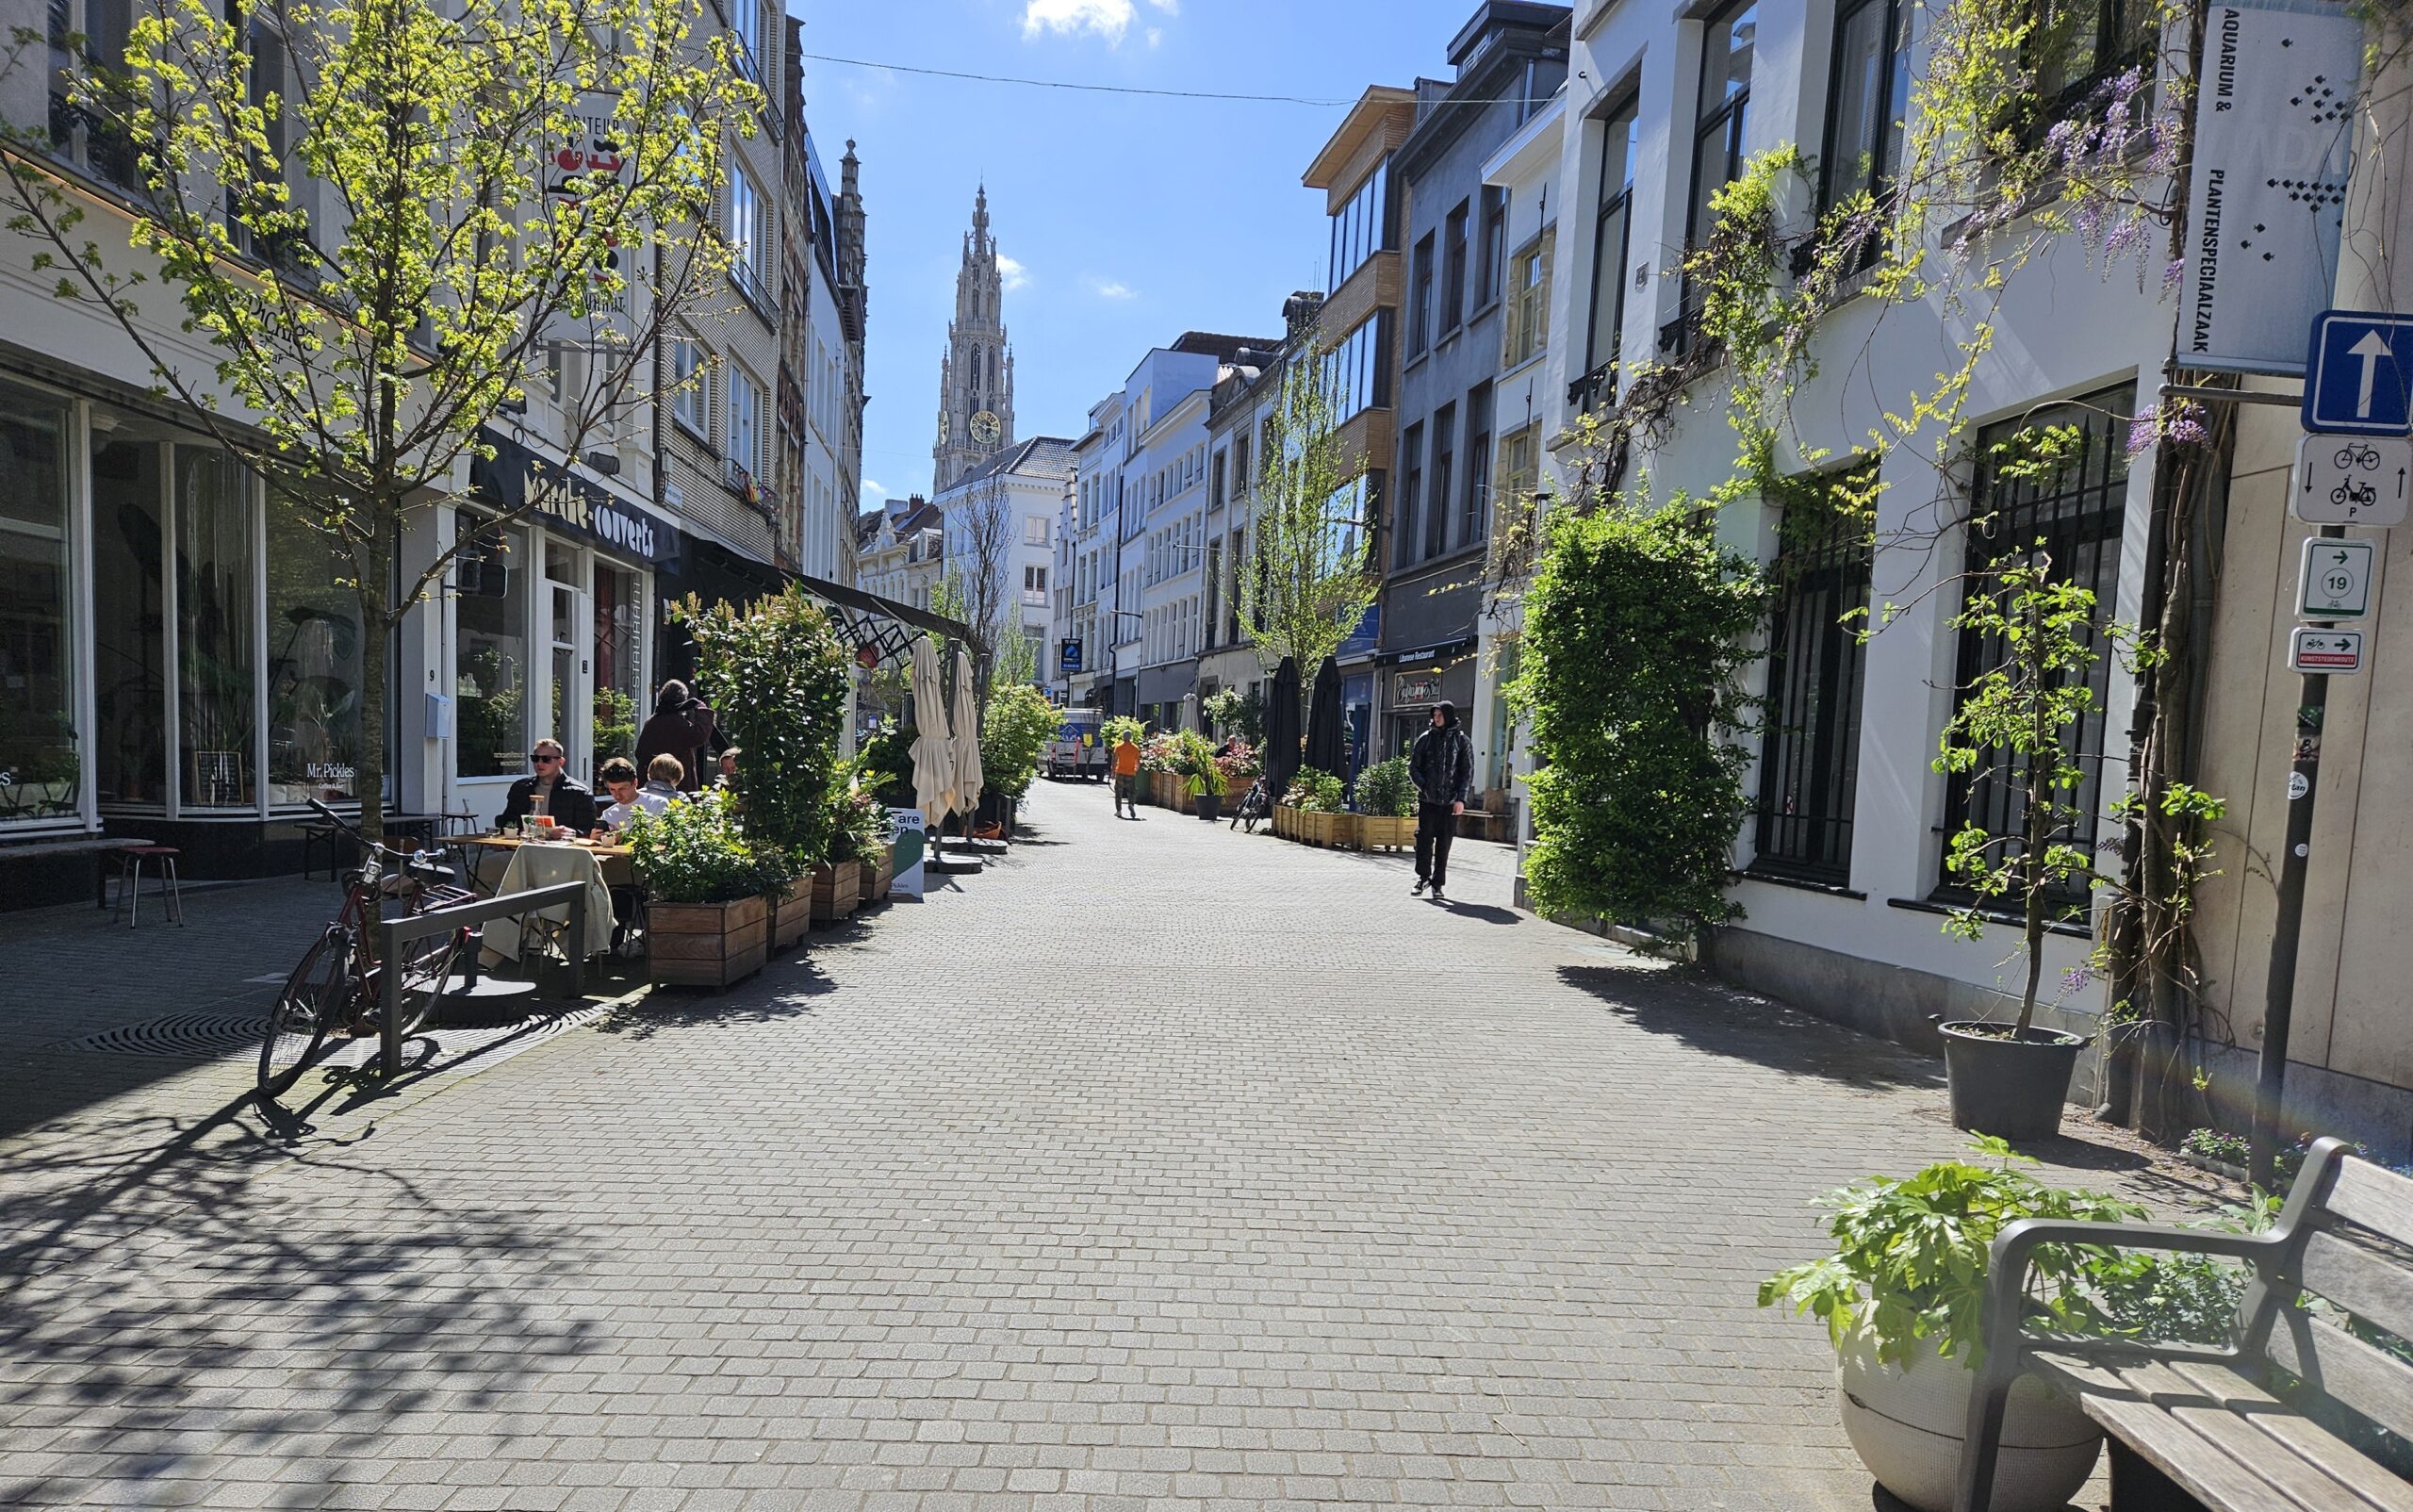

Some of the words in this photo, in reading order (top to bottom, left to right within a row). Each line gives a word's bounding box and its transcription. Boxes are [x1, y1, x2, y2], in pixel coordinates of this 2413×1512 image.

[2217, 8, 2240, 96] AQUARIUM
[2216, 101, 2232, 112] &
[2192, 169, 2224, 353] PLANTENSPECIAALZAAK
[2349, 506, 2357, 518] P
[2327, 576, 2347, 590] 19
[632, 579, 642, 717] RESTAURANT
[429, 669, 435, 682] 9
[306, 763, 322, 778] Mr.
[323, 763, 354, 778] Pickles
[898, 814, 920, 825] are
